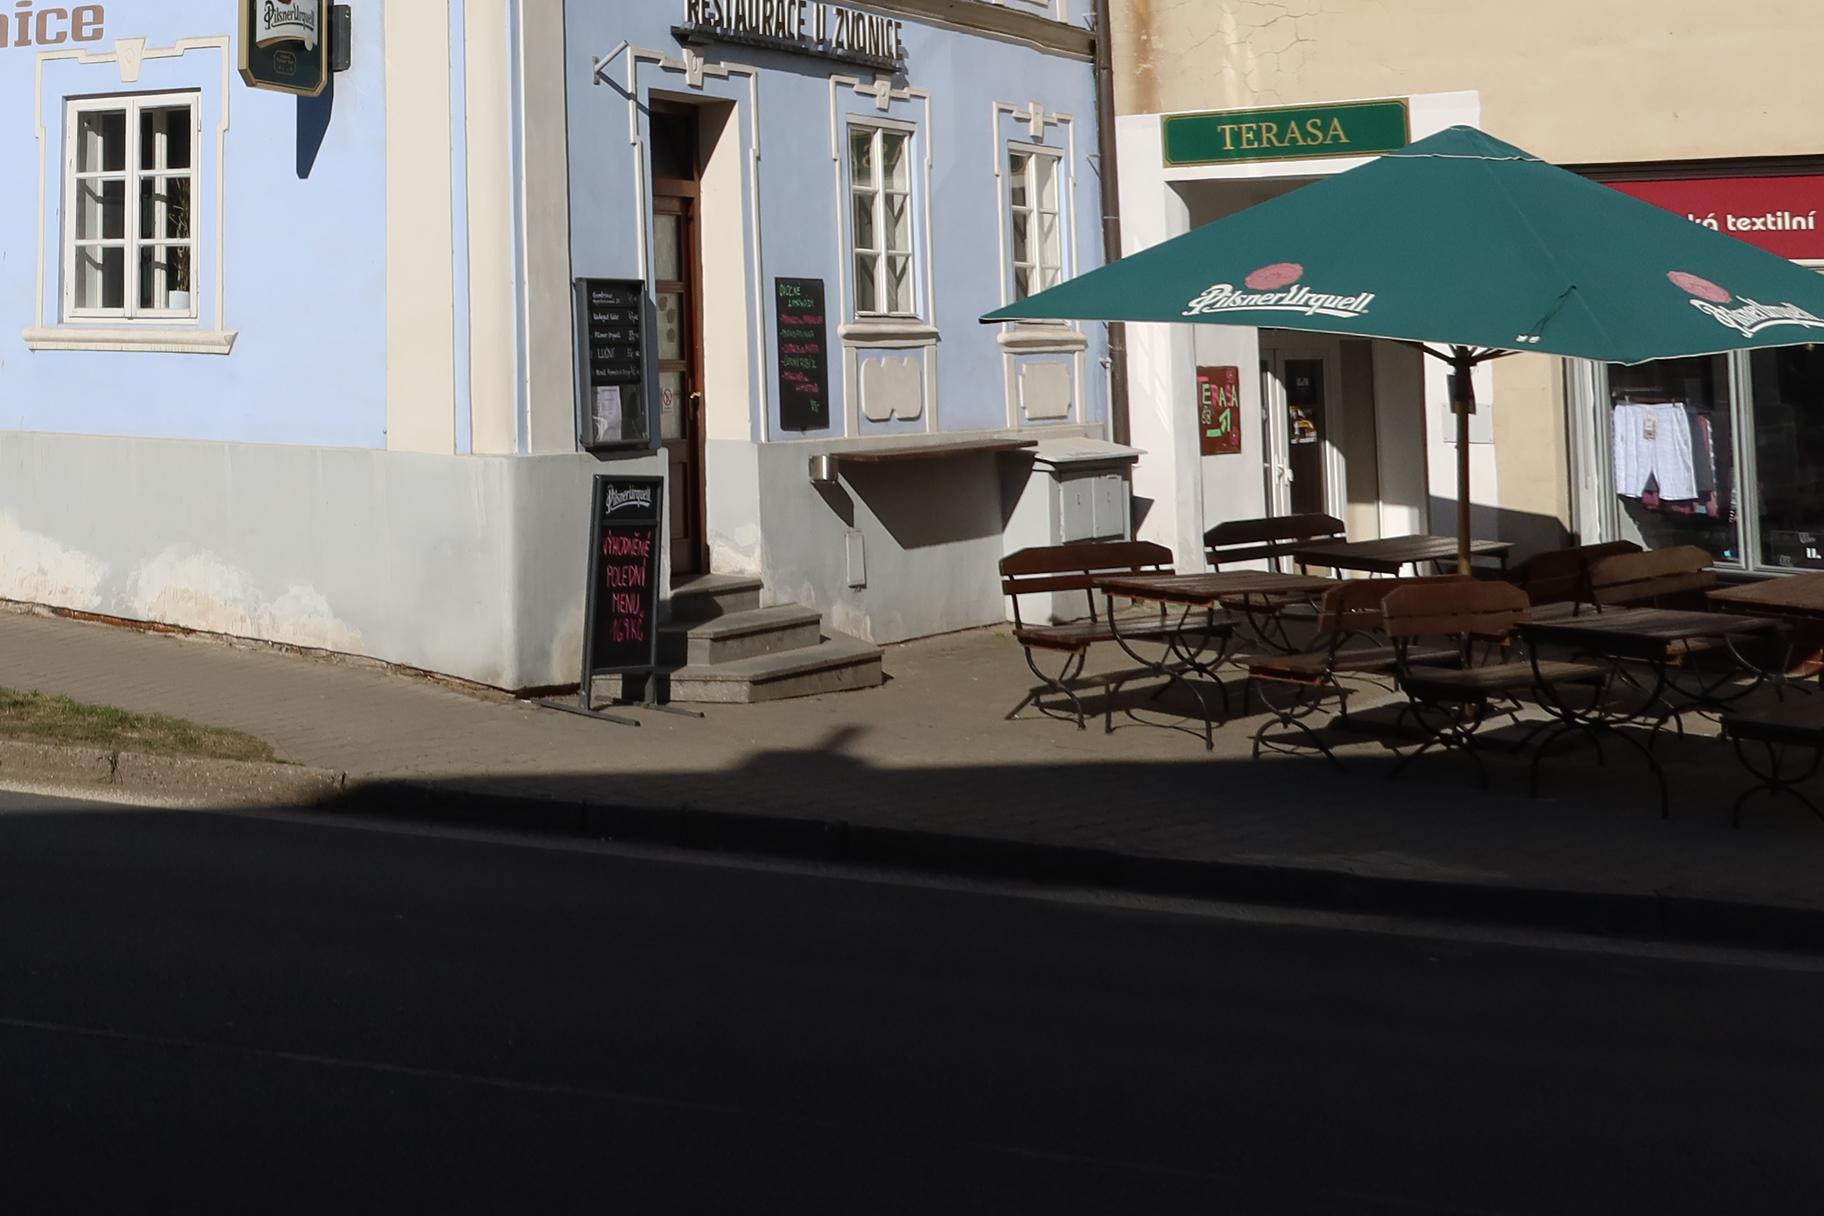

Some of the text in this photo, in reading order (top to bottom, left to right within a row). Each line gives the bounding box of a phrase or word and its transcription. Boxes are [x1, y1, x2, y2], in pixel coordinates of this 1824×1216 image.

[264, 0, 316, 30] Pilsner Urquell
[812, 1, 827, 45] U
[832, 6, 903, 61] ZVONICE
[1217, 117, 1350, 150] TERASA
[1726, 211, 1817, 231] textilní
[1182, 283, 1376, 316] Pilsner Urquell
[606, 558, 646, 588] POLEDNÍ
[612, 592, 640, 614] MENU
